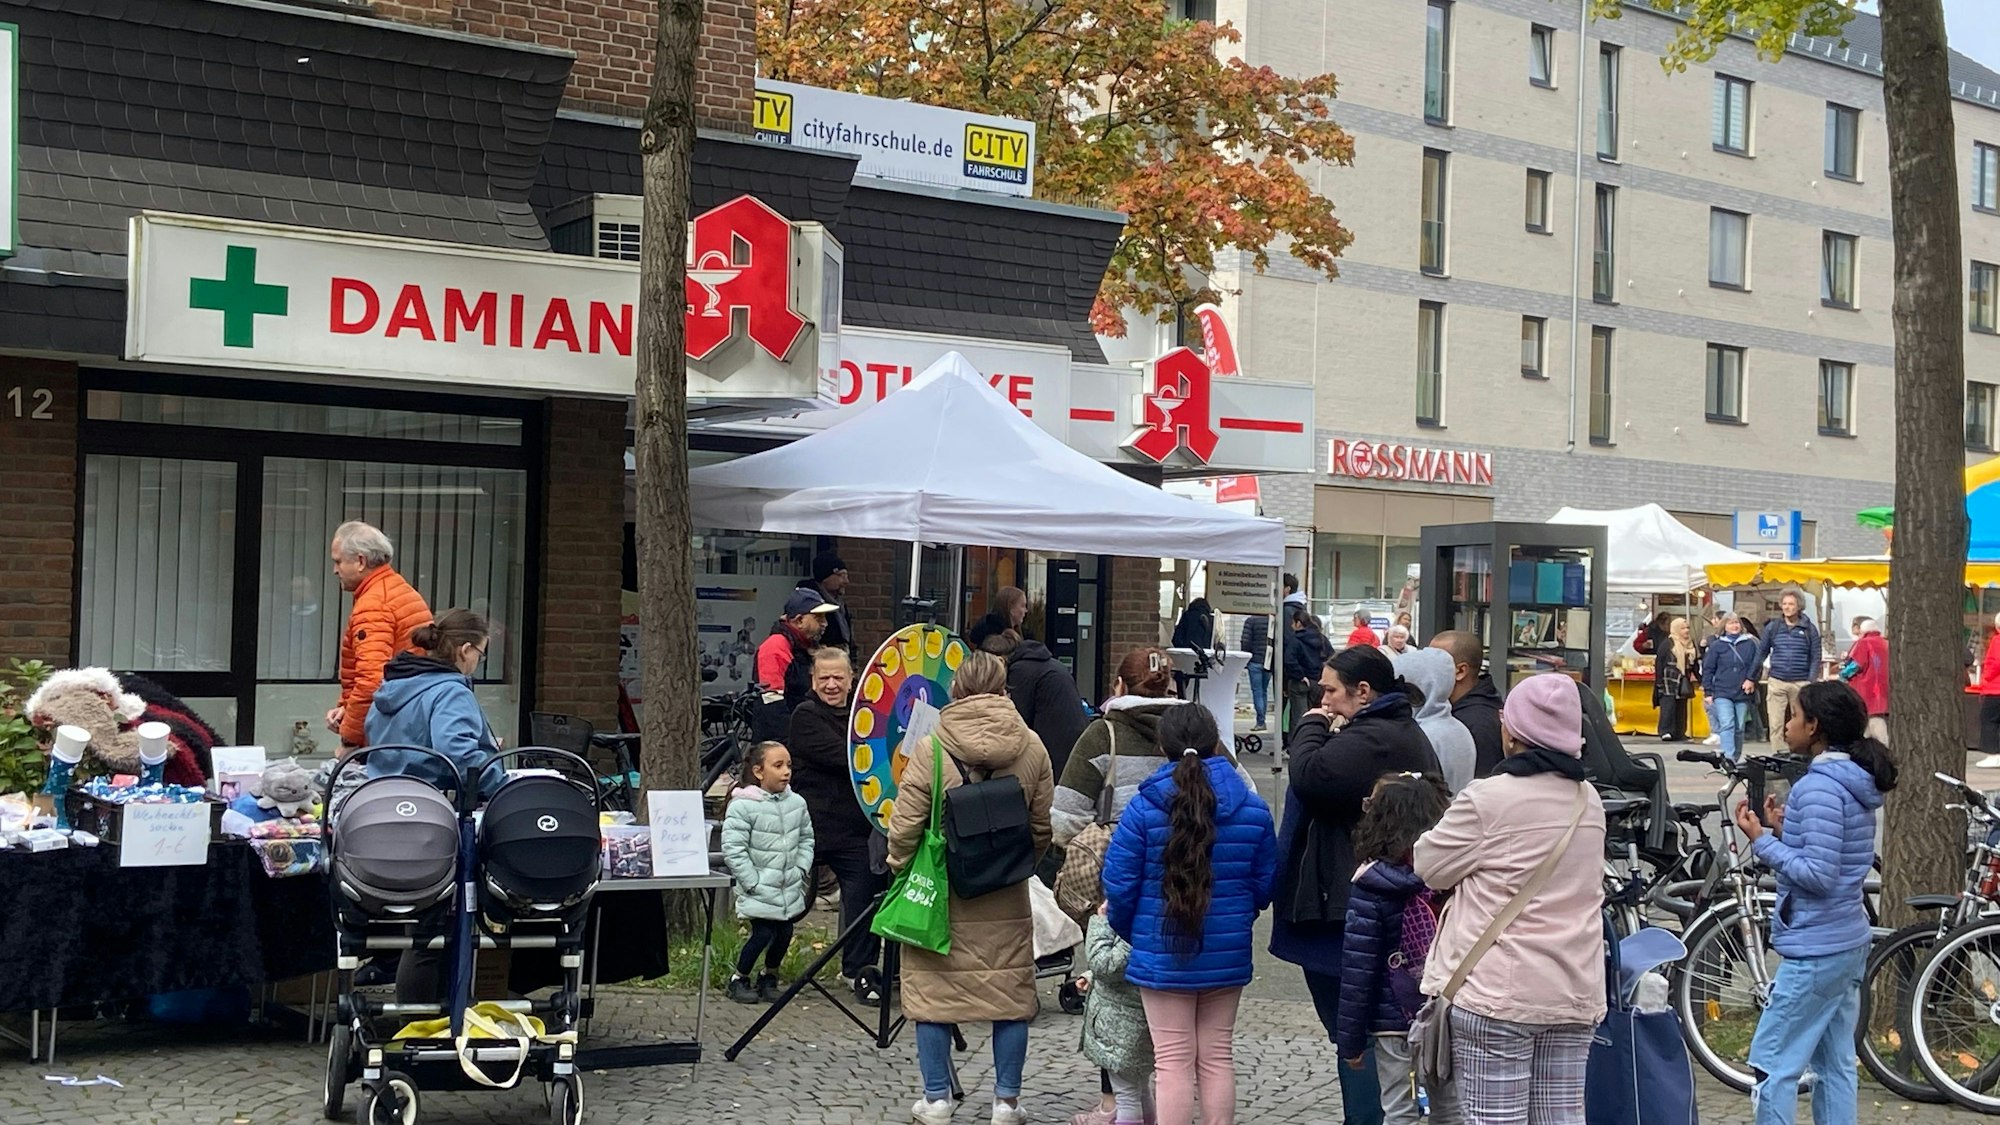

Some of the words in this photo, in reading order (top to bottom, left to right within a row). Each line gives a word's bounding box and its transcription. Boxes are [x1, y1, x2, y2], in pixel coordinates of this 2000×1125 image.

[803, 118, 953, 158] cityfahrschule.de
[968, 131, 1024, 163] CITY
[967, 163, 1024, 182] FAHRSCHULE
[330, 277, 633, 356] DAMIAN
[7, 386, 53, 420] 12
[1327, 439, 1493, 486] ROSSMANN
[1760, 528, 1777, 537] CITY
[652, 807, 688, 826] Trost
